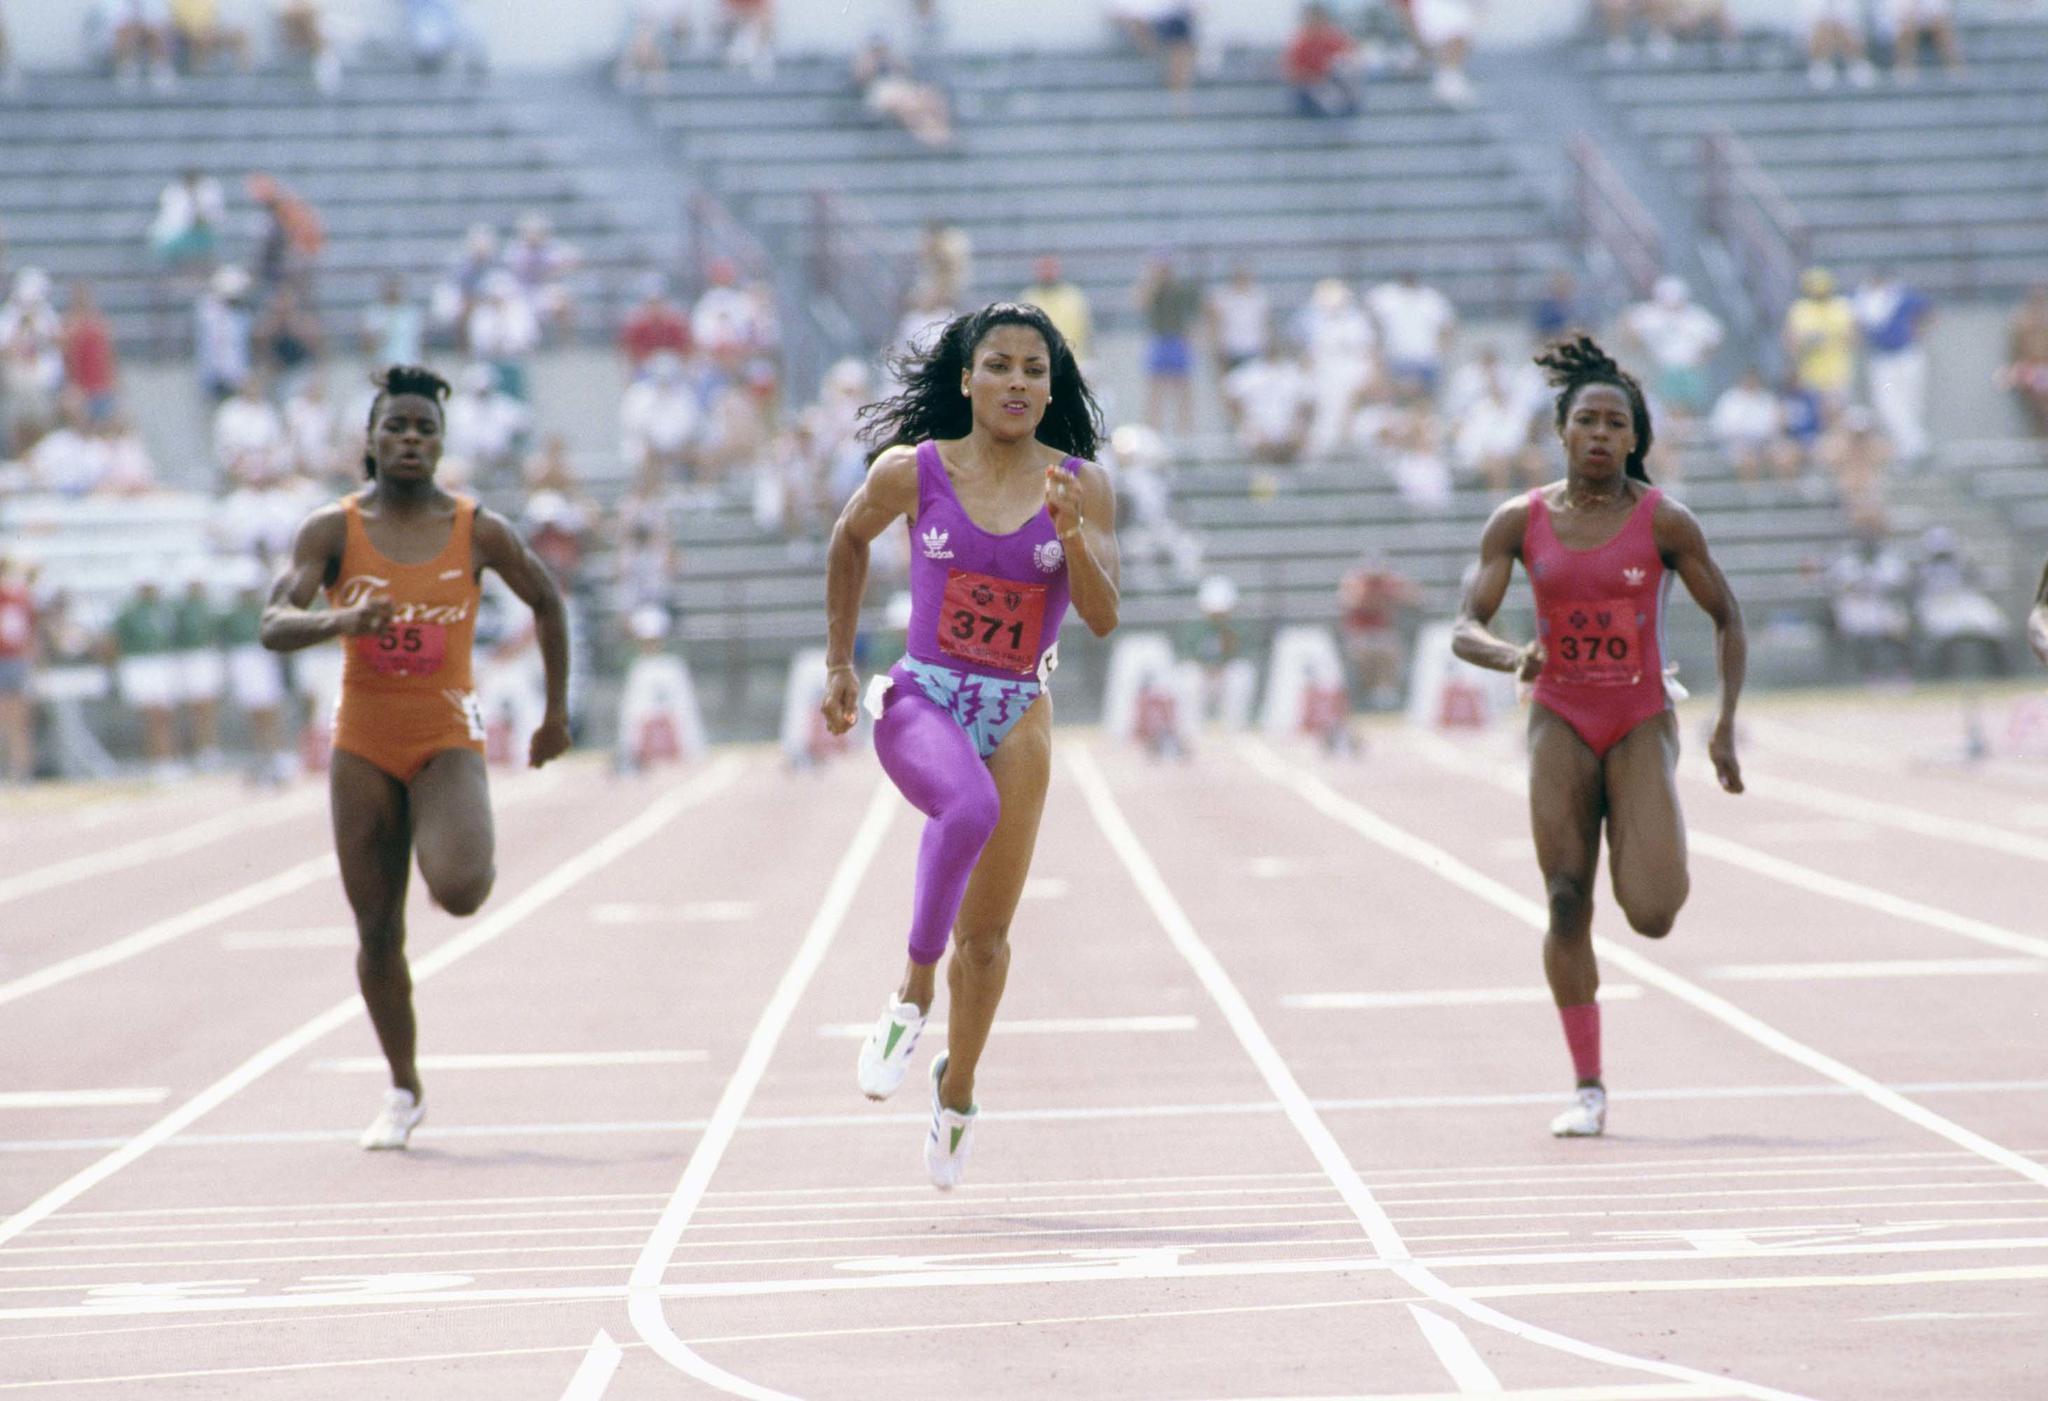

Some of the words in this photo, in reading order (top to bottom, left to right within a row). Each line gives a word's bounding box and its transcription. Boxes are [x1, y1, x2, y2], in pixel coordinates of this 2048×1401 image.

[340, 575, 472, 623] Txas
[952, 610, 1023, 649] 371
[1561, 636, 1628, 660] 370
